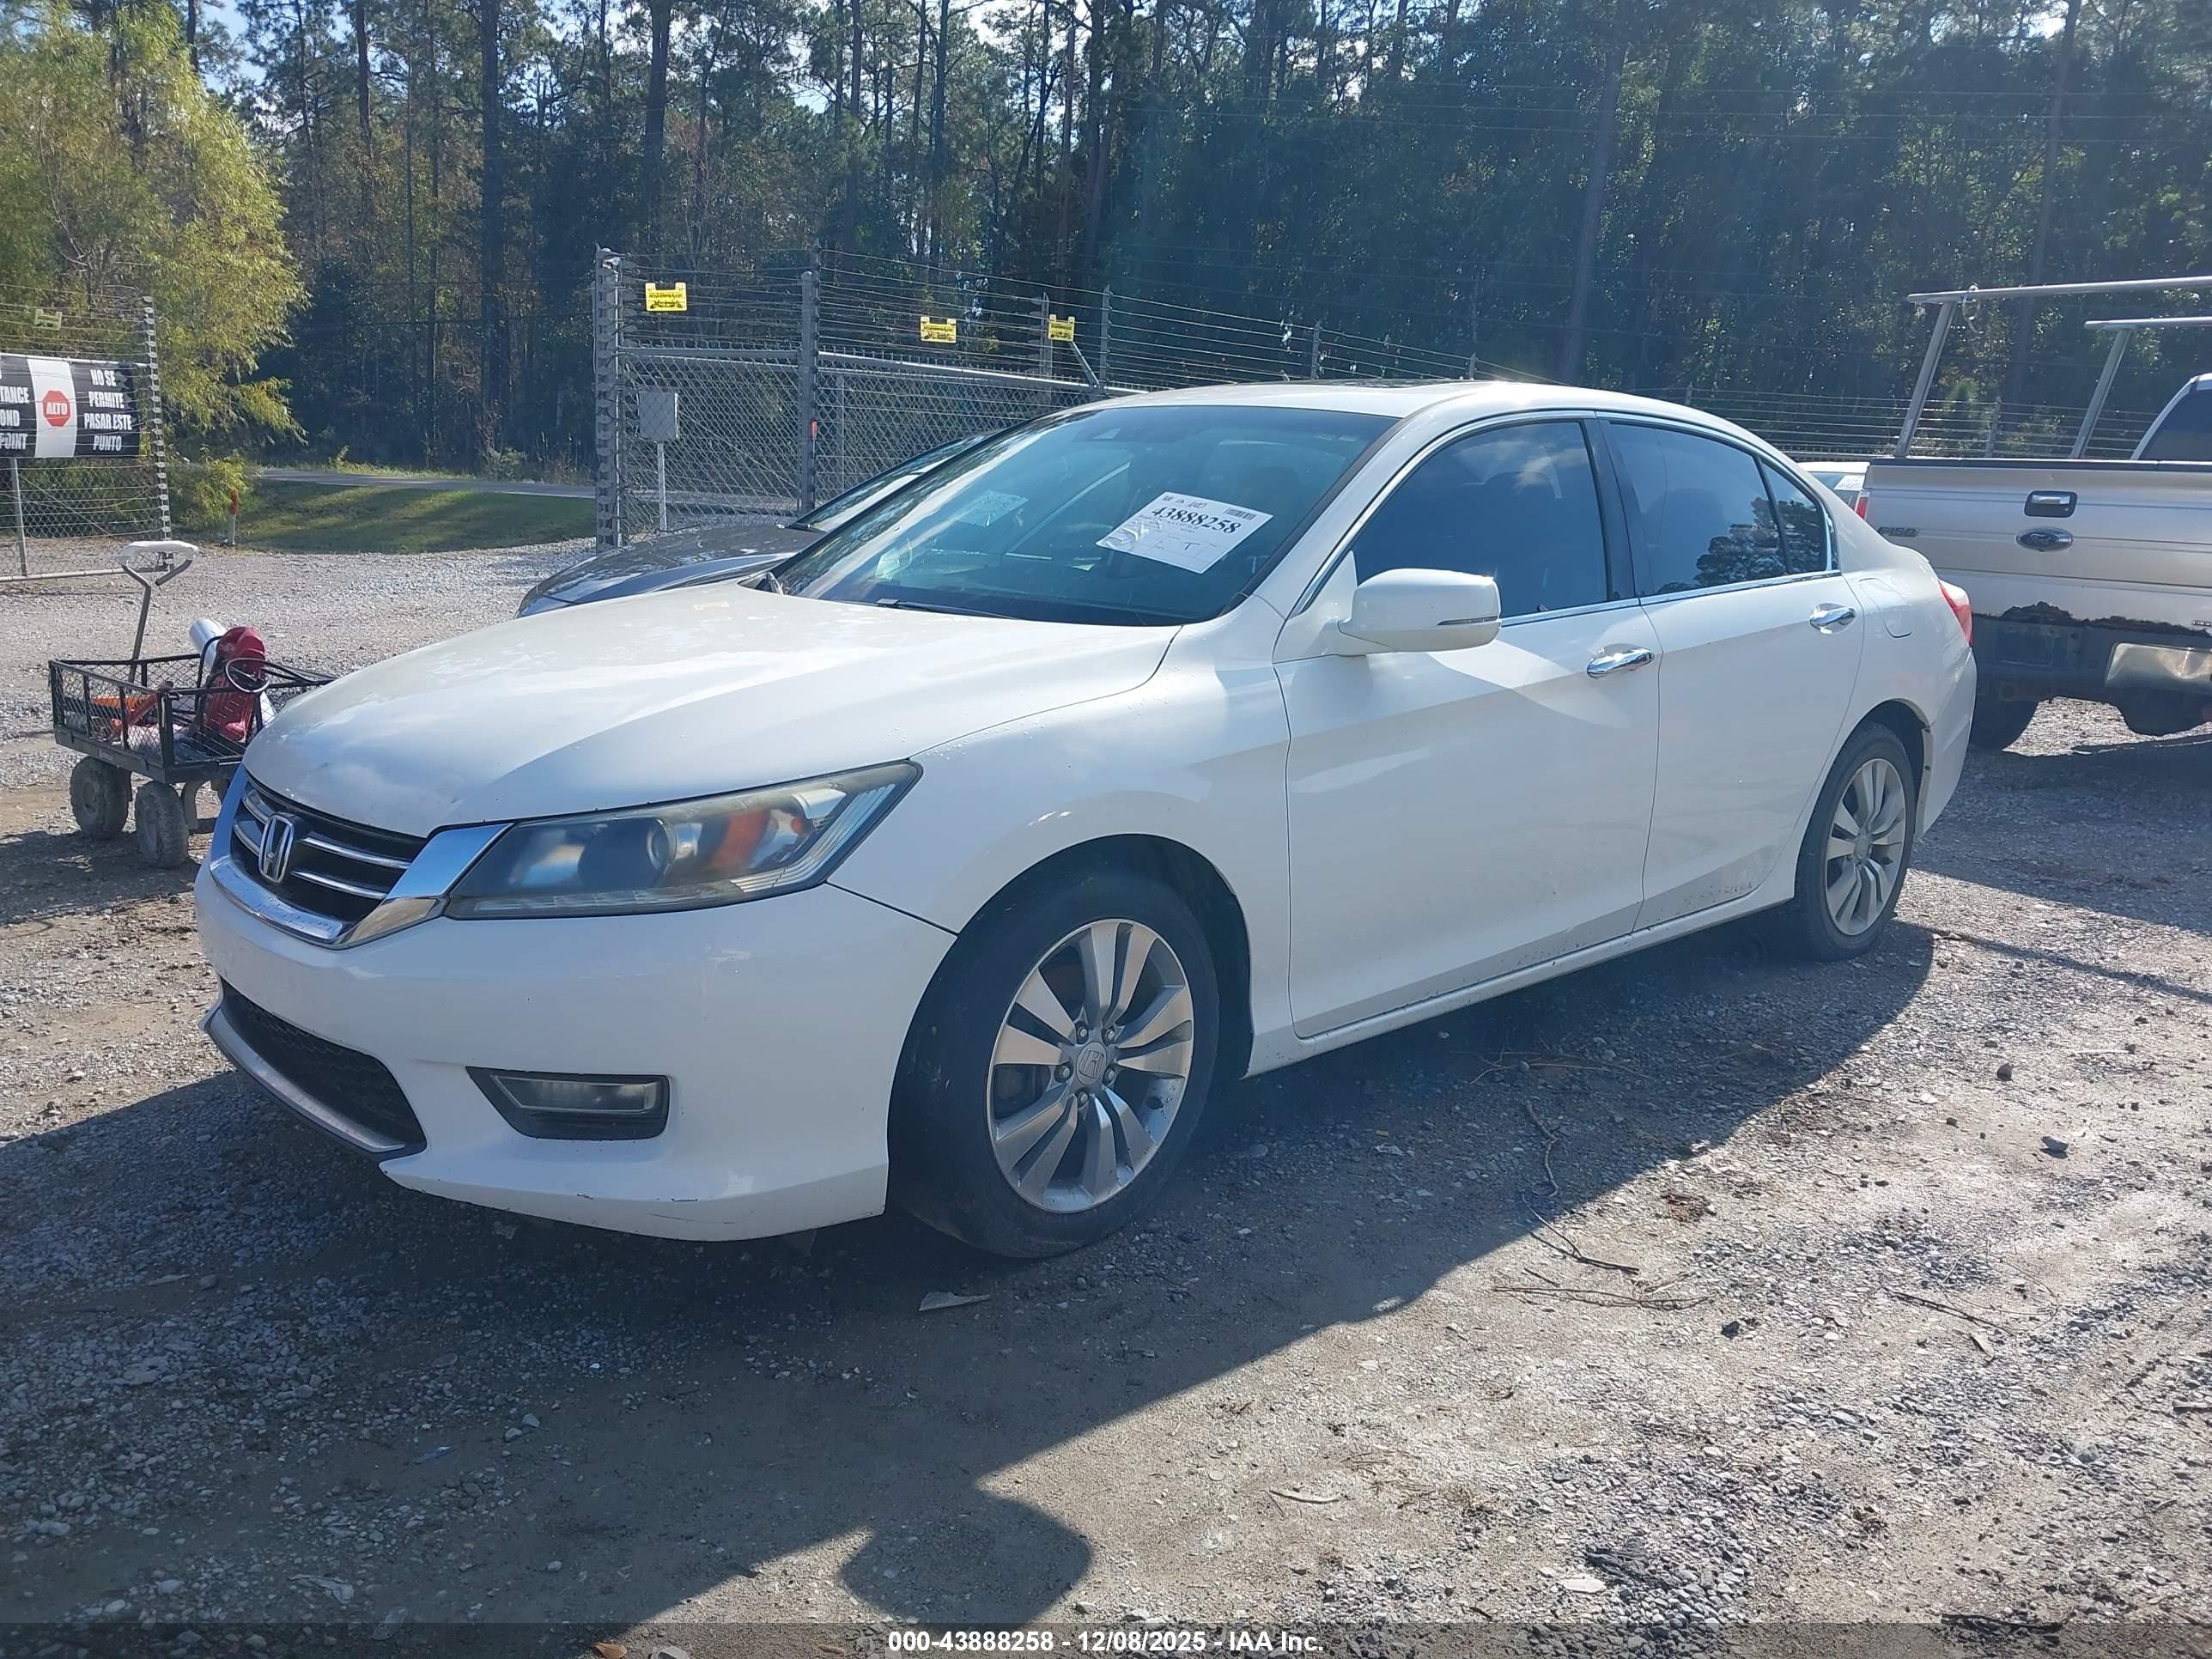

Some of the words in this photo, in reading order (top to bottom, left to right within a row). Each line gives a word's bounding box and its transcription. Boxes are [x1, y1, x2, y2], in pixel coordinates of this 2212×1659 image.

[90, 369, 104, 386] NO
[105, 370, 117, 386] SE
[46, 403, 68, 415] ALTO
[88, 392, 125, 409] PERMITE
[84, 413, 112, 429] PASAR
[112, 414, 132, 430] ESTE
[93, 435, 122, 452] PUNTO
[1152, 506, 1243, 534] 43888258
